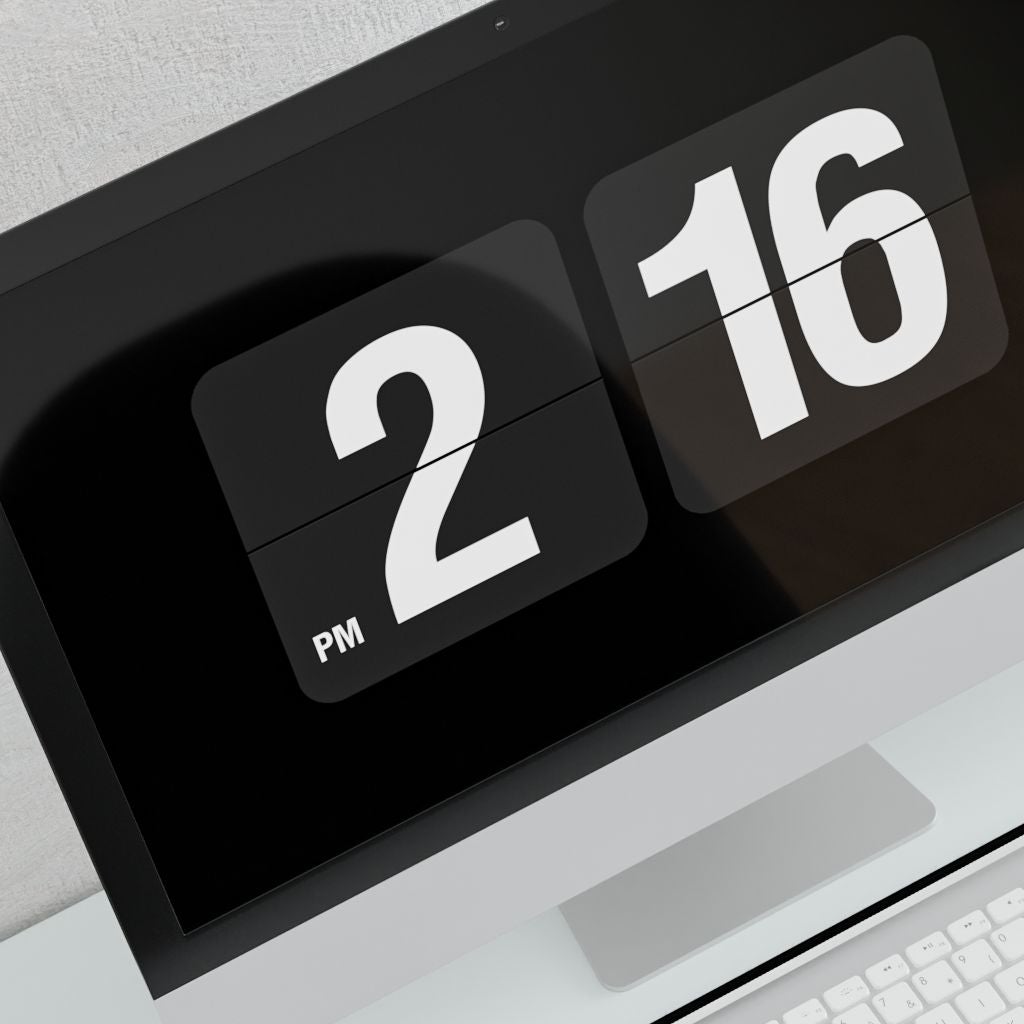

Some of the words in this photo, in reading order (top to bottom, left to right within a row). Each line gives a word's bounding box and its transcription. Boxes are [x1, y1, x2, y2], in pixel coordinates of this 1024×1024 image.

[325, 325, 541, 625] 2
[638, 108, 947, 440] 16
[313, 617, 365, 663] PM
[879, 998, 886, 1007] 7
[919, 976, 928, 986] 8
[958, 954, 966, 964] 9
[998, 933, 1006, 943] 0
